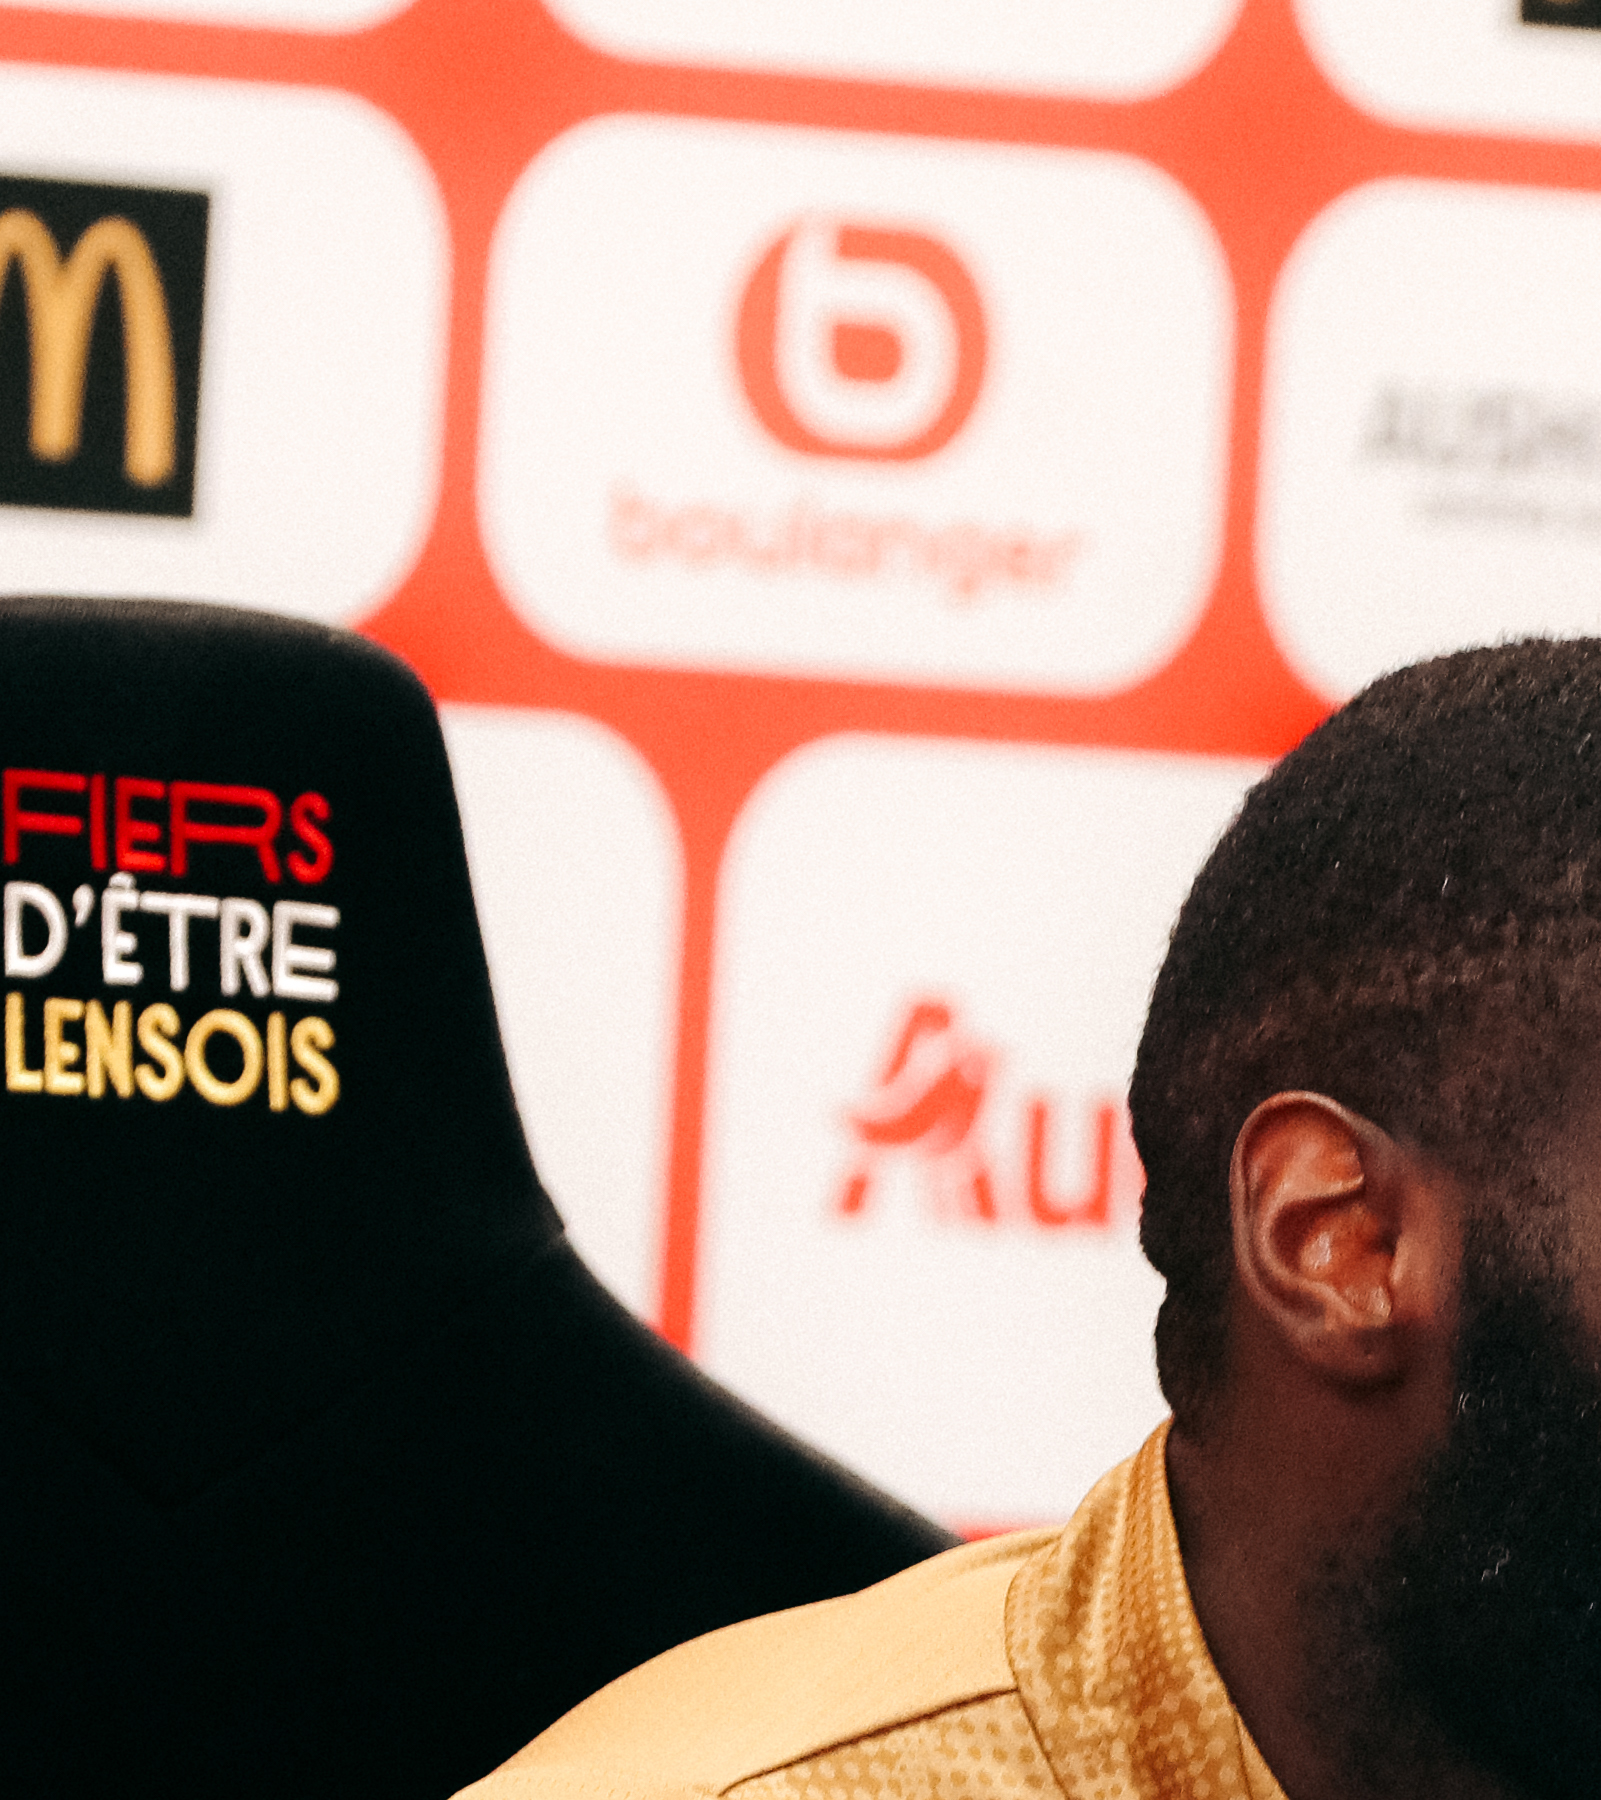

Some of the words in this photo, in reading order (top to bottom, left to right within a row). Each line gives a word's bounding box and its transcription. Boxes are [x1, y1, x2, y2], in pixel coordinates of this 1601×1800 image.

[605, 484, 1086, 612] boulanger
[2, 767, 335, 886] FIERS
[4, 991, 340, 1117] LENSOIS
